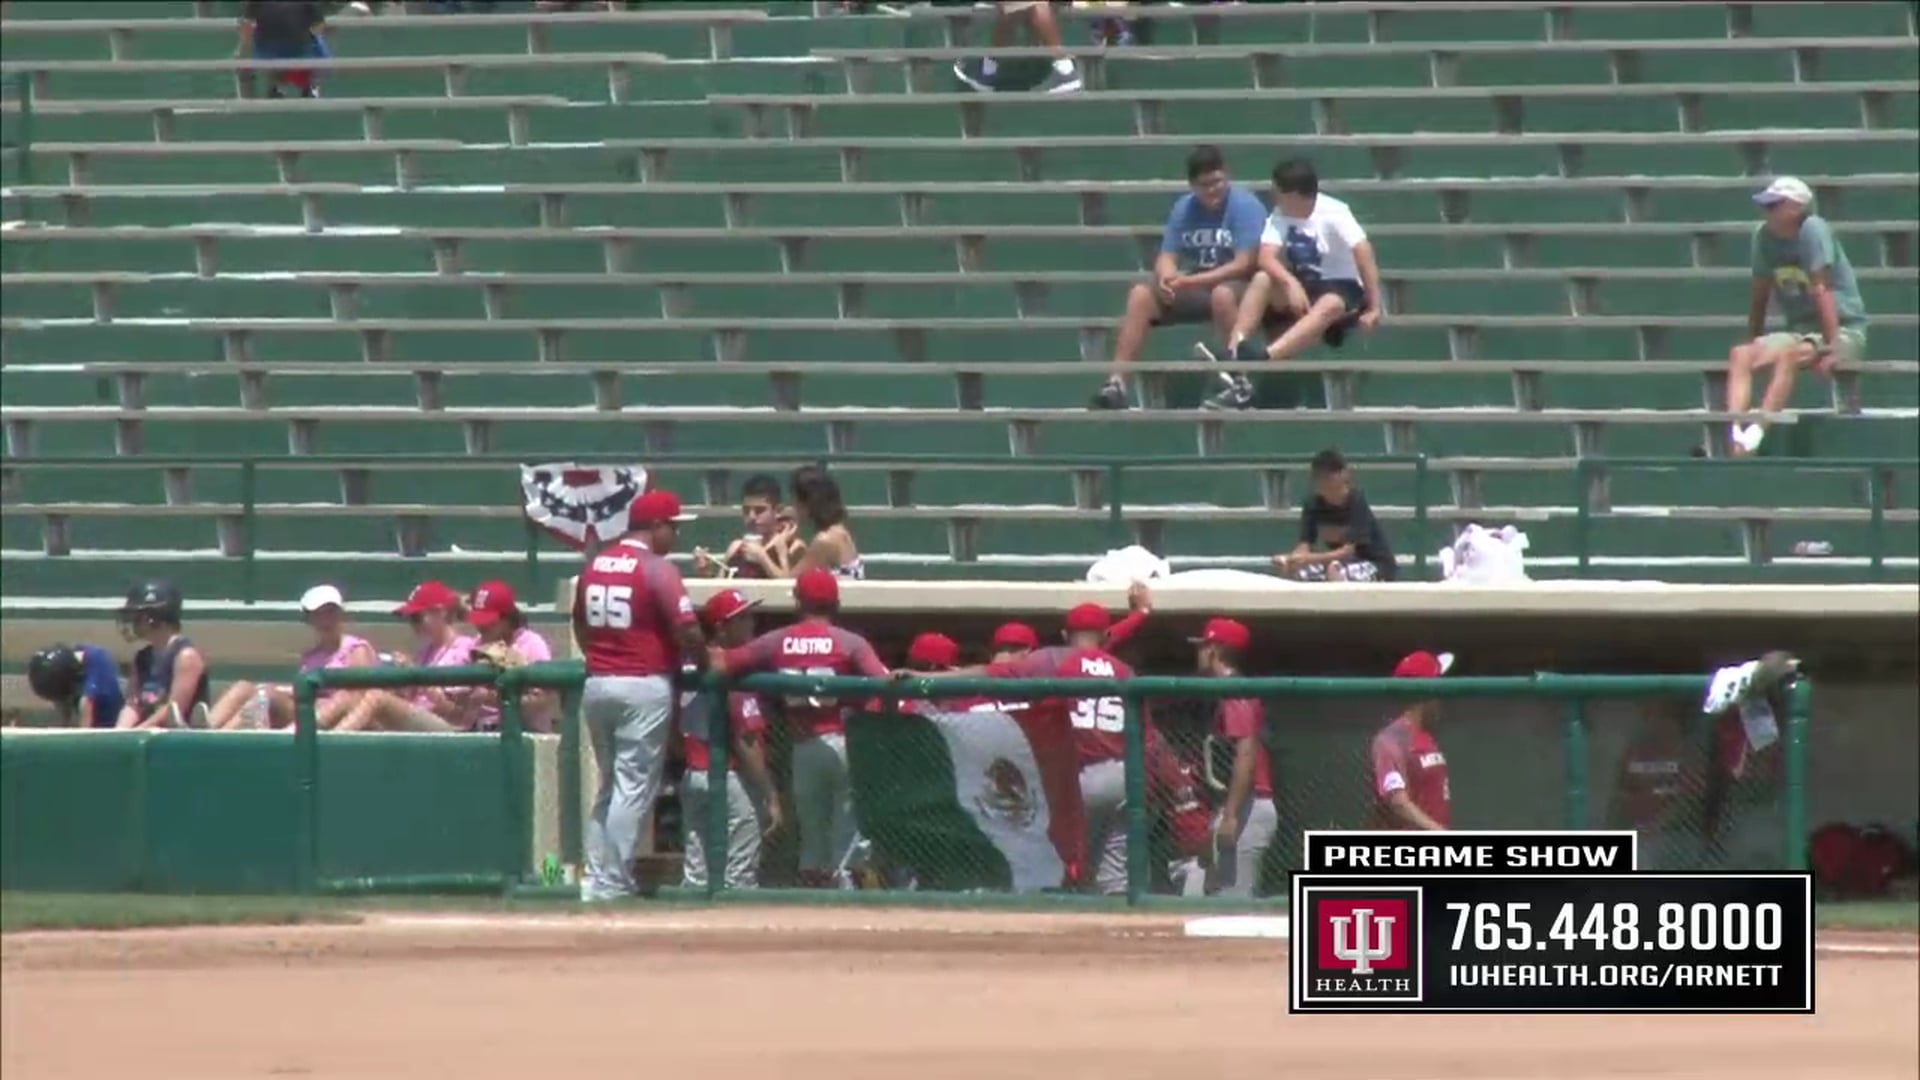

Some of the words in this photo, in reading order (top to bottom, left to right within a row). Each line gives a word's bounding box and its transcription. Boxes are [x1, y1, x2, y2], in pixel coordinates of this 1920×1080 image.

[585, 584, 632, 629] 85
[783, 637, 833, 654] CASTRO
[1069, 696, 1125, 732] 35
